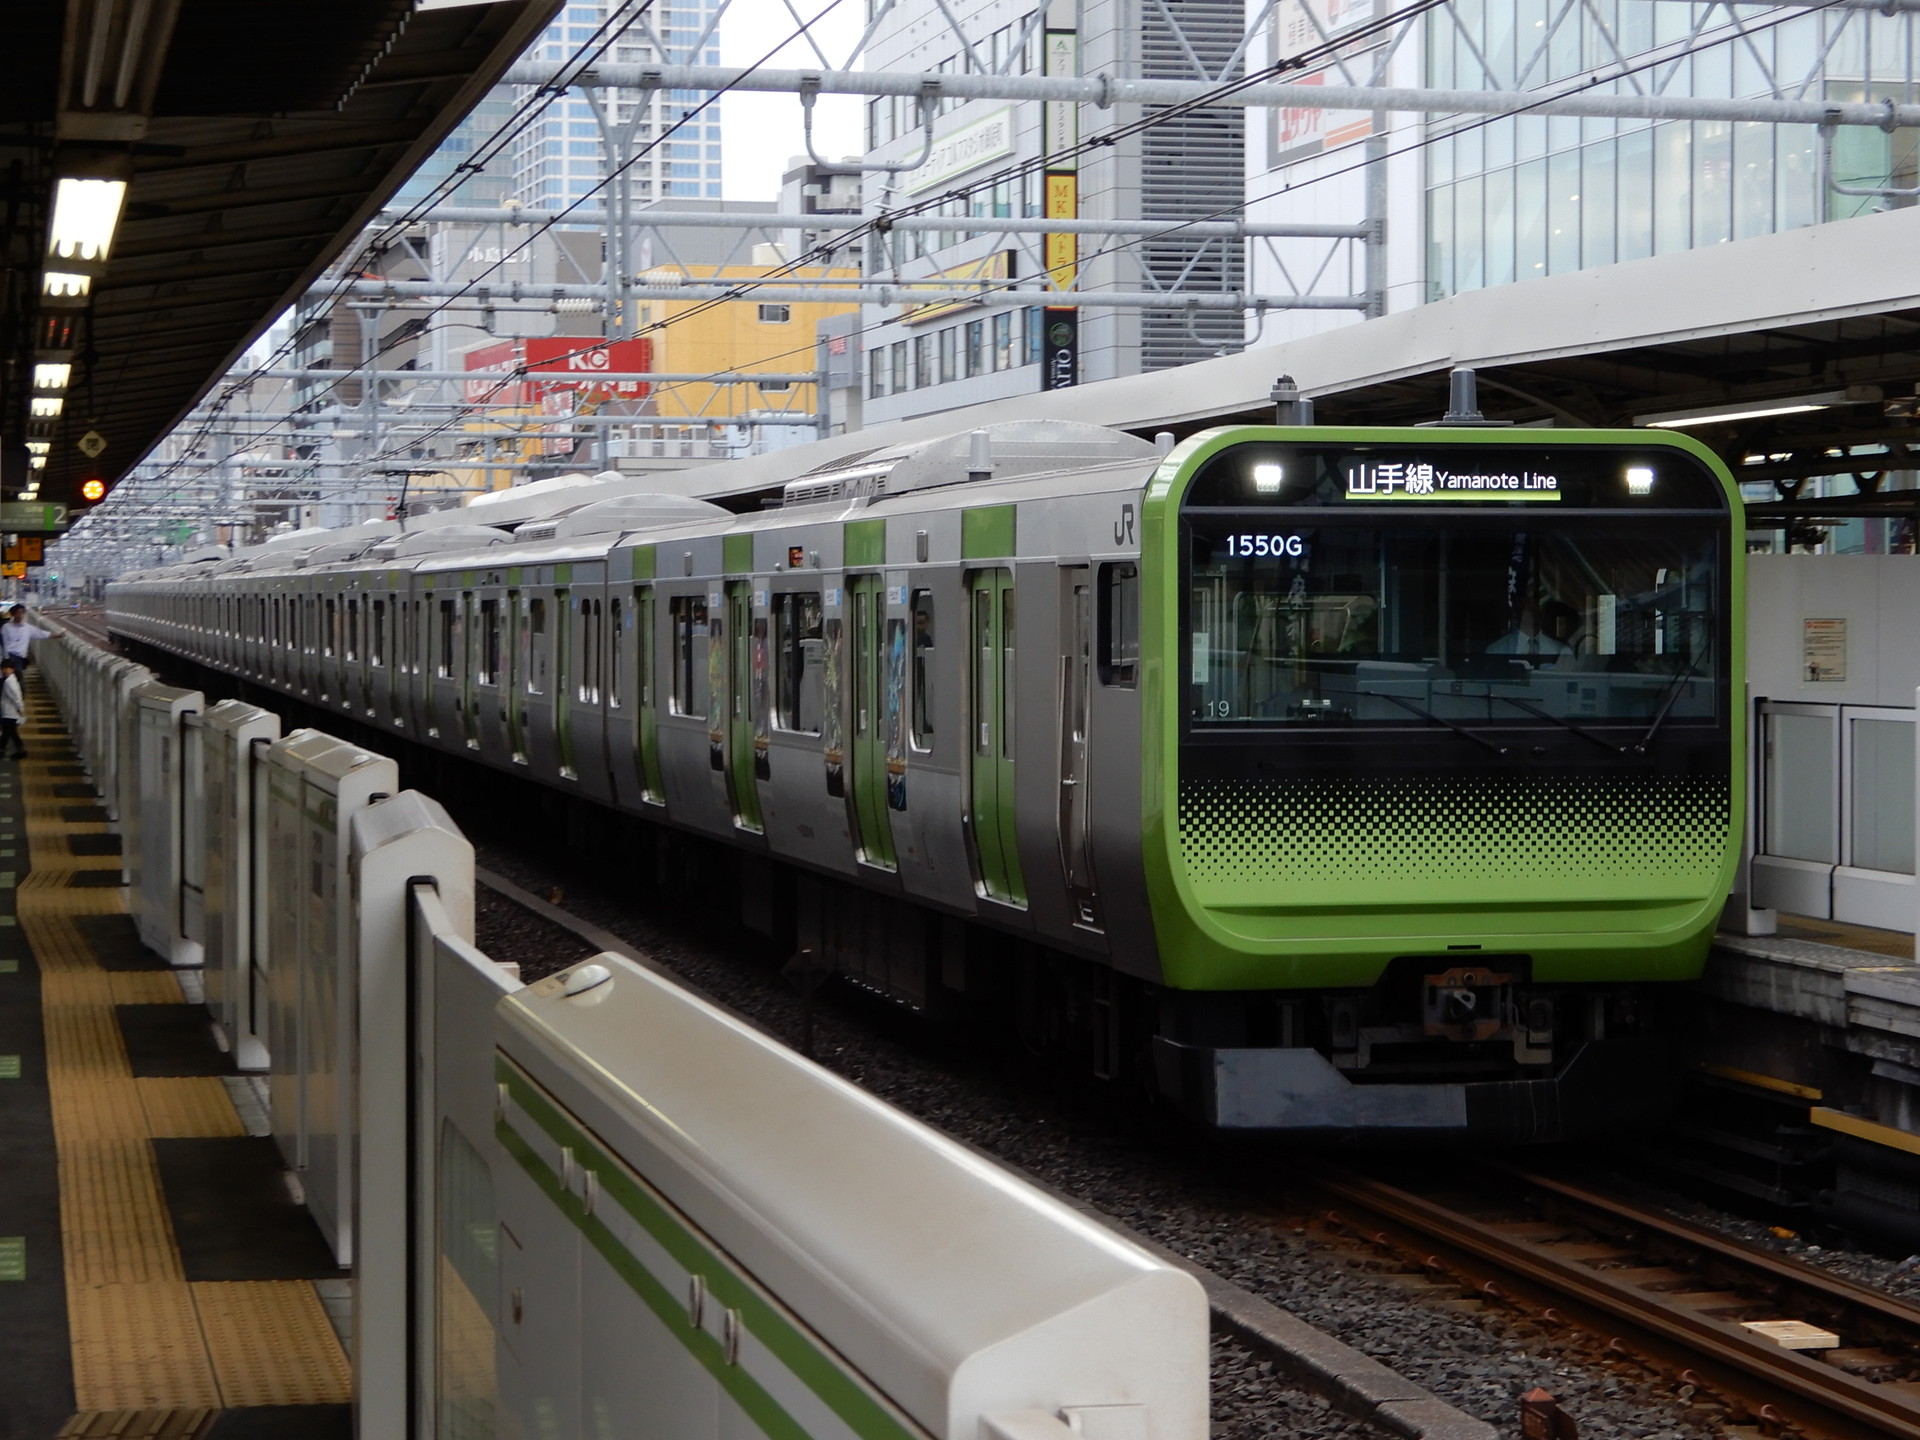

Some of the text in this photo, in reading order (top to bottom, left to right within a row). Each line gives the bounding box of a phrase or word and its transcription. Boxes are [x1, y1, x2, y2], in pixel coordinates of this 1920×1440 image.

[1347, 463, 1557, 495] 山手線 Yamanote Line
[53, 505, 67, 525] 2
[1114, 503, 1134, 547] JR
[1226, 534, 1303, 557] 1550G
[1207, 699, 1230, 718] 19
